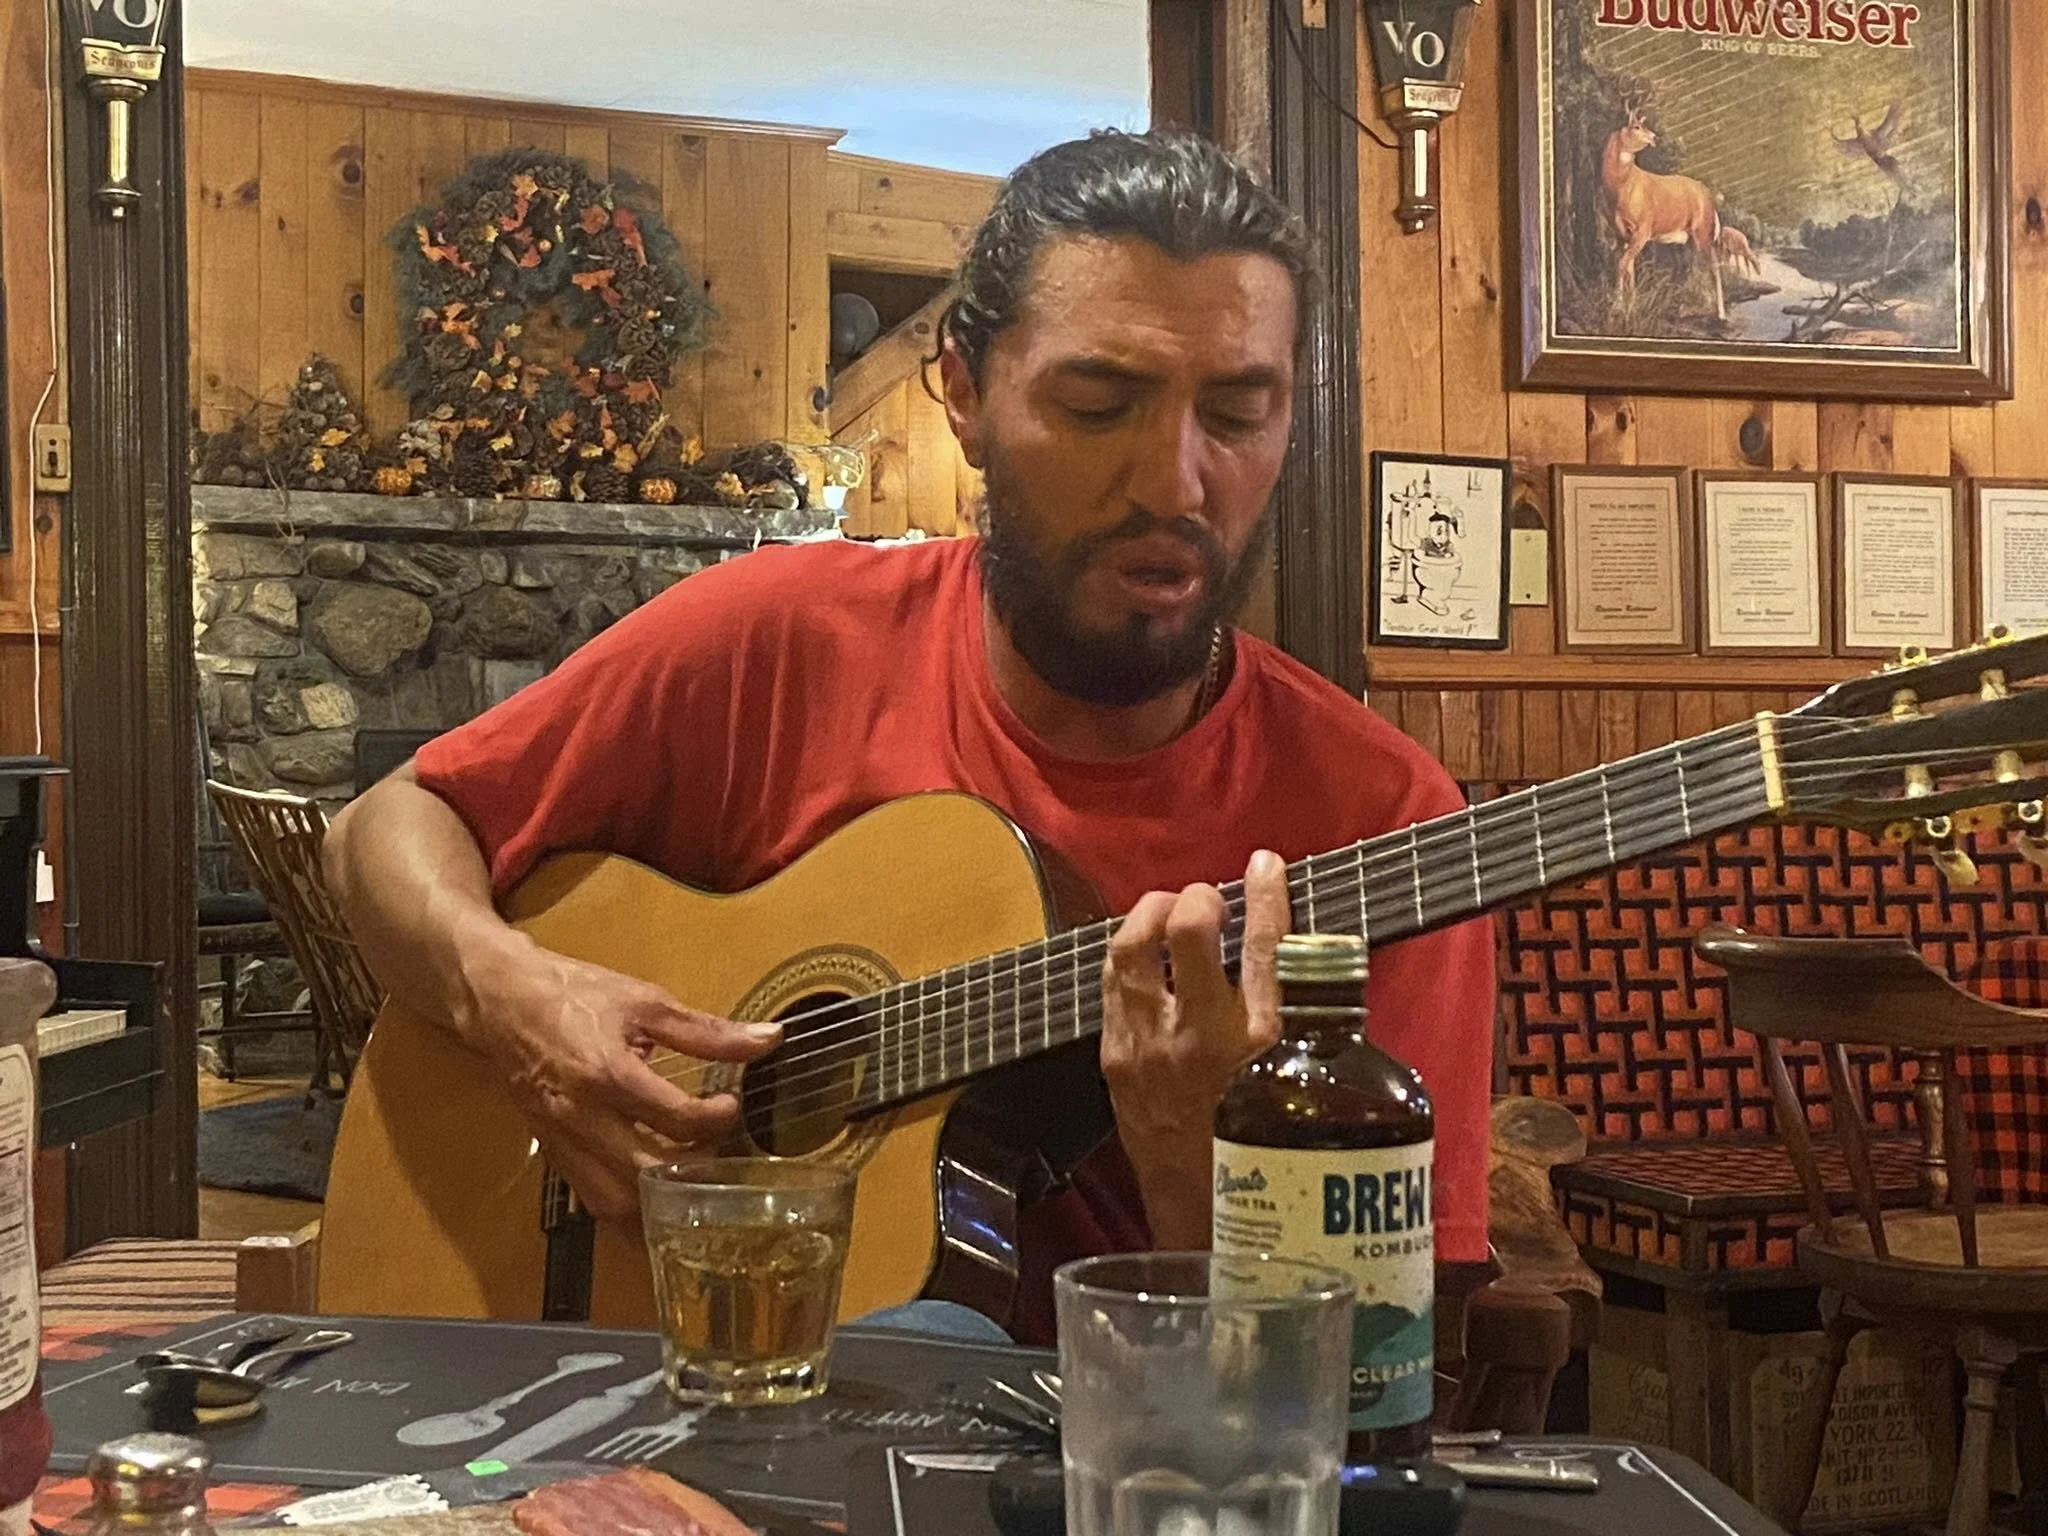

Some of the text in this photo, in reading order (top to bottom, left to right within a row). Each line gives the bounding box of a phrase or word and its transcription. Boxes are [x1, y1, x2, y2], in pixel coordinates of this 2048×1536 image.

[1382, 21, 1446, 68] VO
[1322, 1166, 1426, 1235] BREW
[1829, 1423, 1884, 1445] YORK
